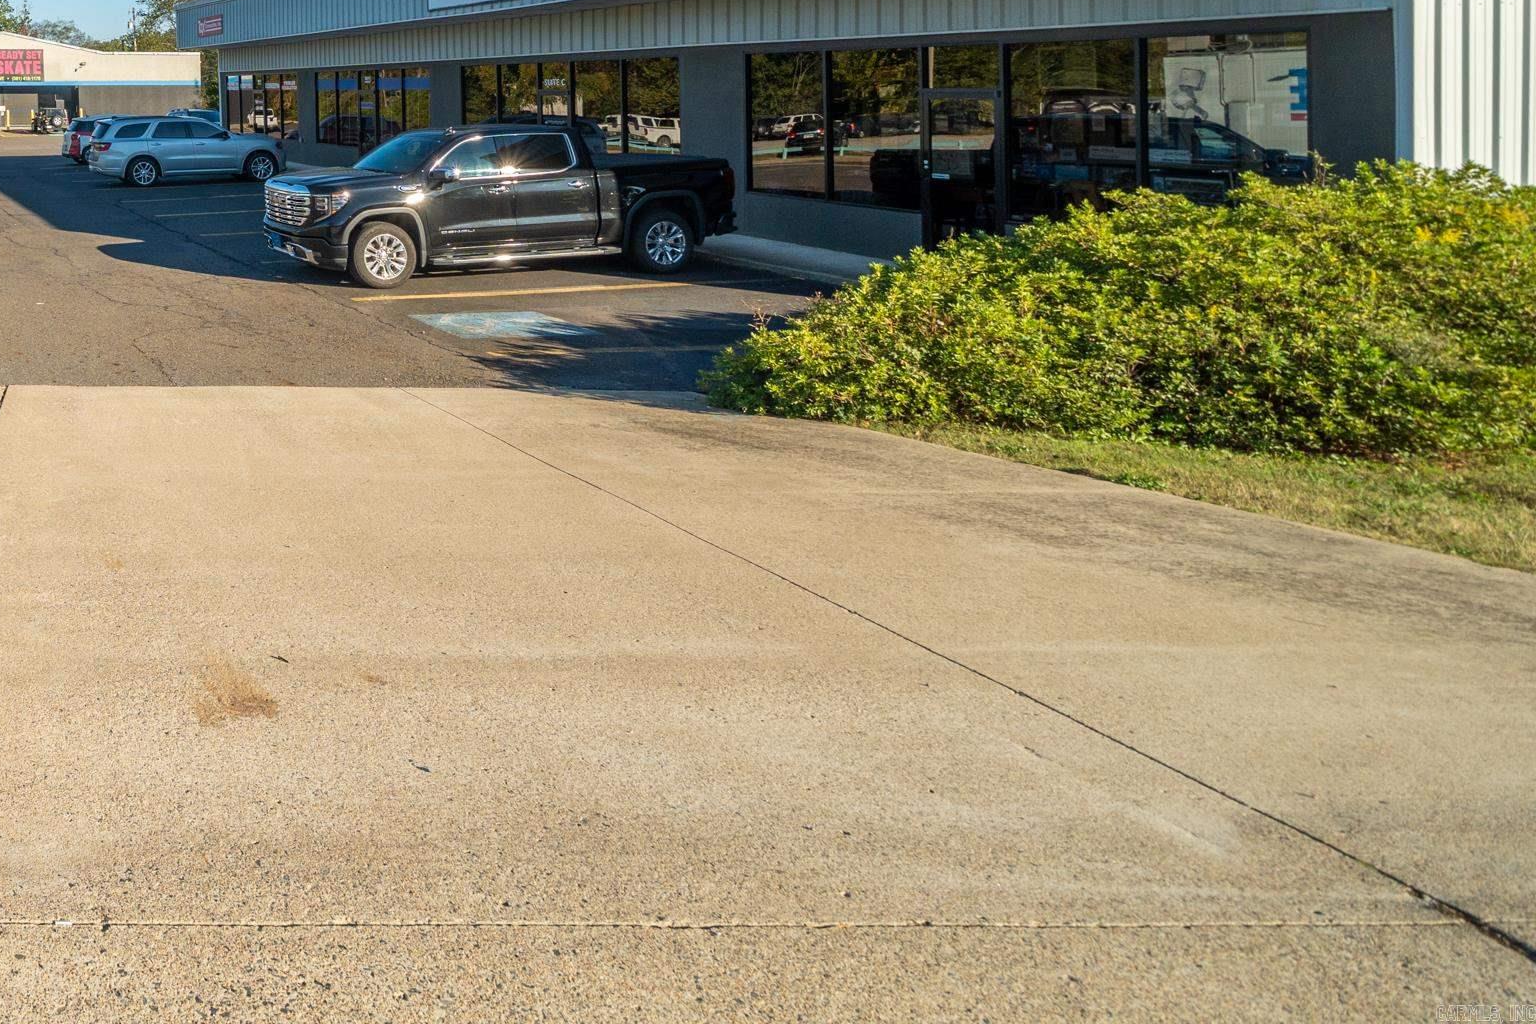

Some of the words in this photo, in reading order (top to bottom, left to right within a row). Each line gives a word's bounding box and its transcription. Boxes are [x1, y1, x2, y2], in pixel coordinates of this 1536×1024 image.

[26, 50, 42, 60] SET
[544, 78, 560, 86] SUITE
[561, 78, 566, 86] C
